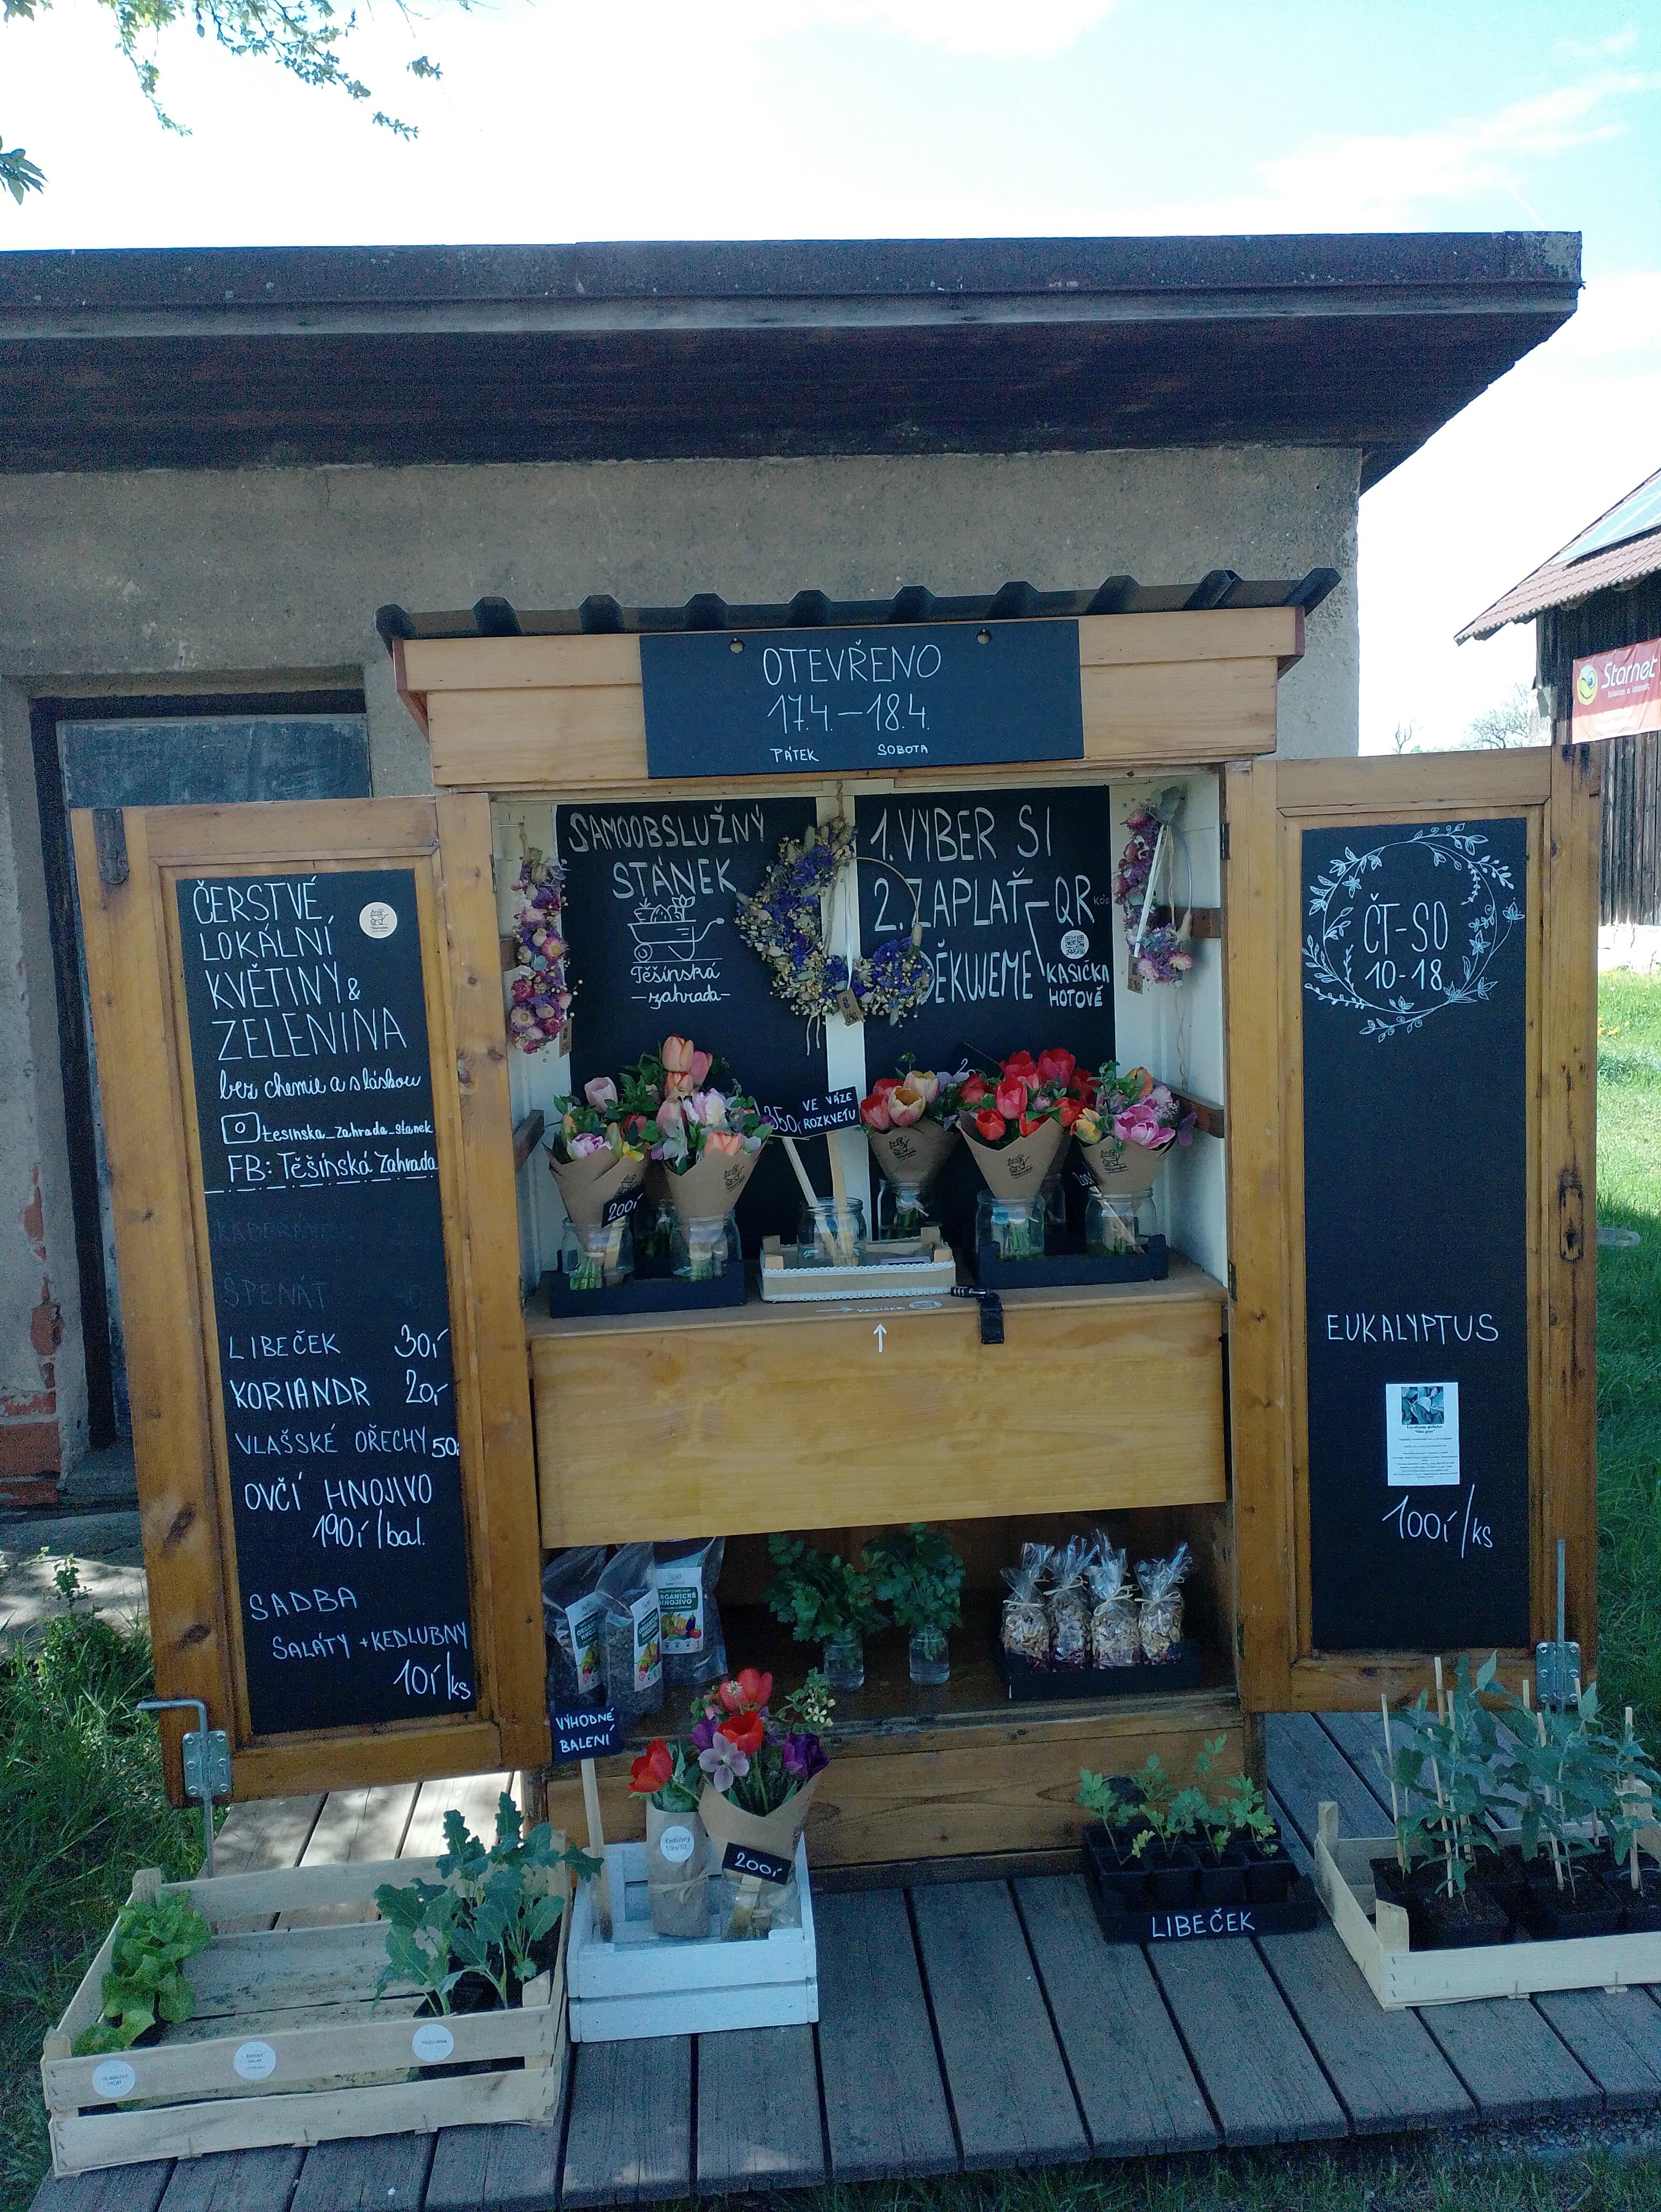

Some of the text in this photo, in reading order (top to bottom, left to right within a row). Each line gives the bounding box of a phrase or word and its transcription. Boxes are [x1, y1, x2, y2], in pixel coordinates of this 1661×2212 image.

[762, 639, 942, 685] OTEVŘENO
[1601, 654, 1658, 689] Starnet
[769, 744, 928, 763] PÁTEK SOBOTA
[569, 802, 765, 852] SAMOOBSLUŽNÝ
[1017, 805, 1051, 858] SI
[612, 854, 738, 899] STÁNEK
[193, 874, 323, 925] ČERSTVÉ
[1055, 874, 1095, 927] QR
[205, 960, 361, 1010] KVĚTINY &
[630, 962, 720, 984] Těšínská
[1046, 959, 1110, 984] KASIČKA
[1365, 959, 1443, 990] 10-18
[212, 1007, 407, 1061] ZELENINA
[219, 1069, 259, 1100] bez
[264, 1071, 326, 1099] chemie
[330, 1077, 346, 1093] a
[362, 1067, 421, 1090] láskou
[802, 1091, 853, 1111] VE VÁZE
[803, 1108, 856, 1130] ROZKVETU
[228, 1147, 438, 1183] FB: Těšínská Zahrada
[607, 1192, 644, 1222] 200,-
[229, 1330, 341, 1359] LIBEČEK
[1327, 1313, 1499, 1345] EUKALYPTUS
[229, 1377, 370, 1410] KORIANDR
[235, 1423, 338, 1455] VLAŠSKÉ
[355, 1424, 427, 1454] OŘECHY
[244, 1472, 432, 1511] OVČÍ HNOJIVO
[249, 1587, 357, 1621] SADBA
[272, 1631, 350, 1660] SALÁTY
[555, 1708, 615, 1731] VÝHODNÉ
[560, 1725, 615, 1753] BALENÍ
[735, 1852, 782, 1877] 200,-
[1152, 1907, 1255, 1938] LIBEČEK
